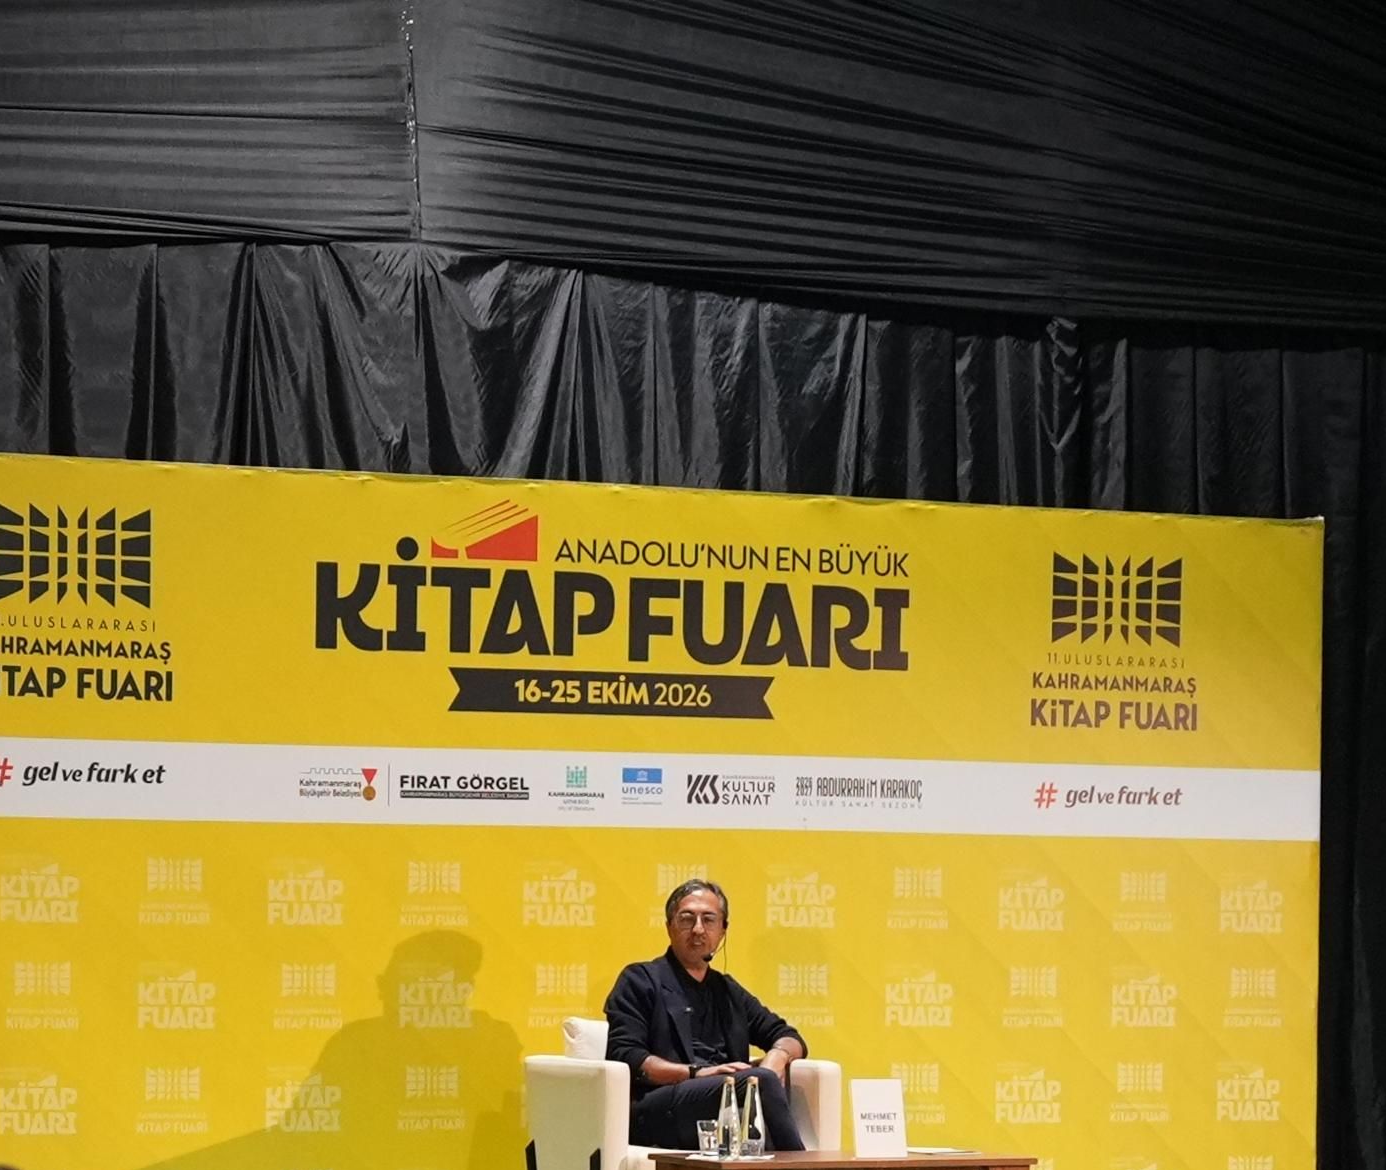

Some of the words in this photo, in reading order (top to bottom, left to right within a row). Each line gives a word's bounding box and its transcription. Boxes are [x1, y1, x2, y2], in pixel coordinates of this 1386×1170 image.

[554, 538, 769, 572] ANADOLU'NUN
[776, 546, 811, 574] EN
[819, 541, 910, 578] BÜYÜK
[315, 535, 614, 657] KİTAP
[628, 576, 910, 671] FUARI
[77, 667, 173, 702] FUARI
[514, 678, 581, 704] 16-25
[588, 672, 649, 705] EKİM
[654, 680, 712, 707] 2026
[1031, 672, 1197, 698] KAHRAMANMARAŞ
[1119, 702, 1198, 732] FUARI
[22, 761, 59, 787] gel
[62, 768, 83, 782] ve
[86, 762, 138, 783] fark
[142, 765, 166, 784] et
[400, 775, 451, 790] FIRAT
[457, 773, 530, 791] GÖRGEL
[622, 786, 663, 795] unesco
[722, 793, 771, 806] SANAT
[880, 779, 922, 803] KARAKOÇ
[1065, 785, 1095, 808] gel
[1096, 790, 1114, 804] ve
[1116, 786, 1160, 806] fark
[1162, 788, 1183, 806] et
[0, 900, 79, 922] FUARI
[268, 903, 342, 925] FUARI
[523, 905, 596, 927] FUARI
[766, 907, 836, 928] FUARI
[999, 911, 1064, 931] FUARI
[1220, 913, 1283, 933] FUARI
[138, 1007, 215, 1029] FUARI
[400, 1006, 473, 1028] FUARI
[885, 1006, 952, 1027] FUARI
[1111, 1007, 1175, 1028] FUARI
[266, 1110, 341, 1132] FUARI
[996, 1102, 1061, 1123] FUARI
[1217, 1101, 1280, 1121] FUARI
